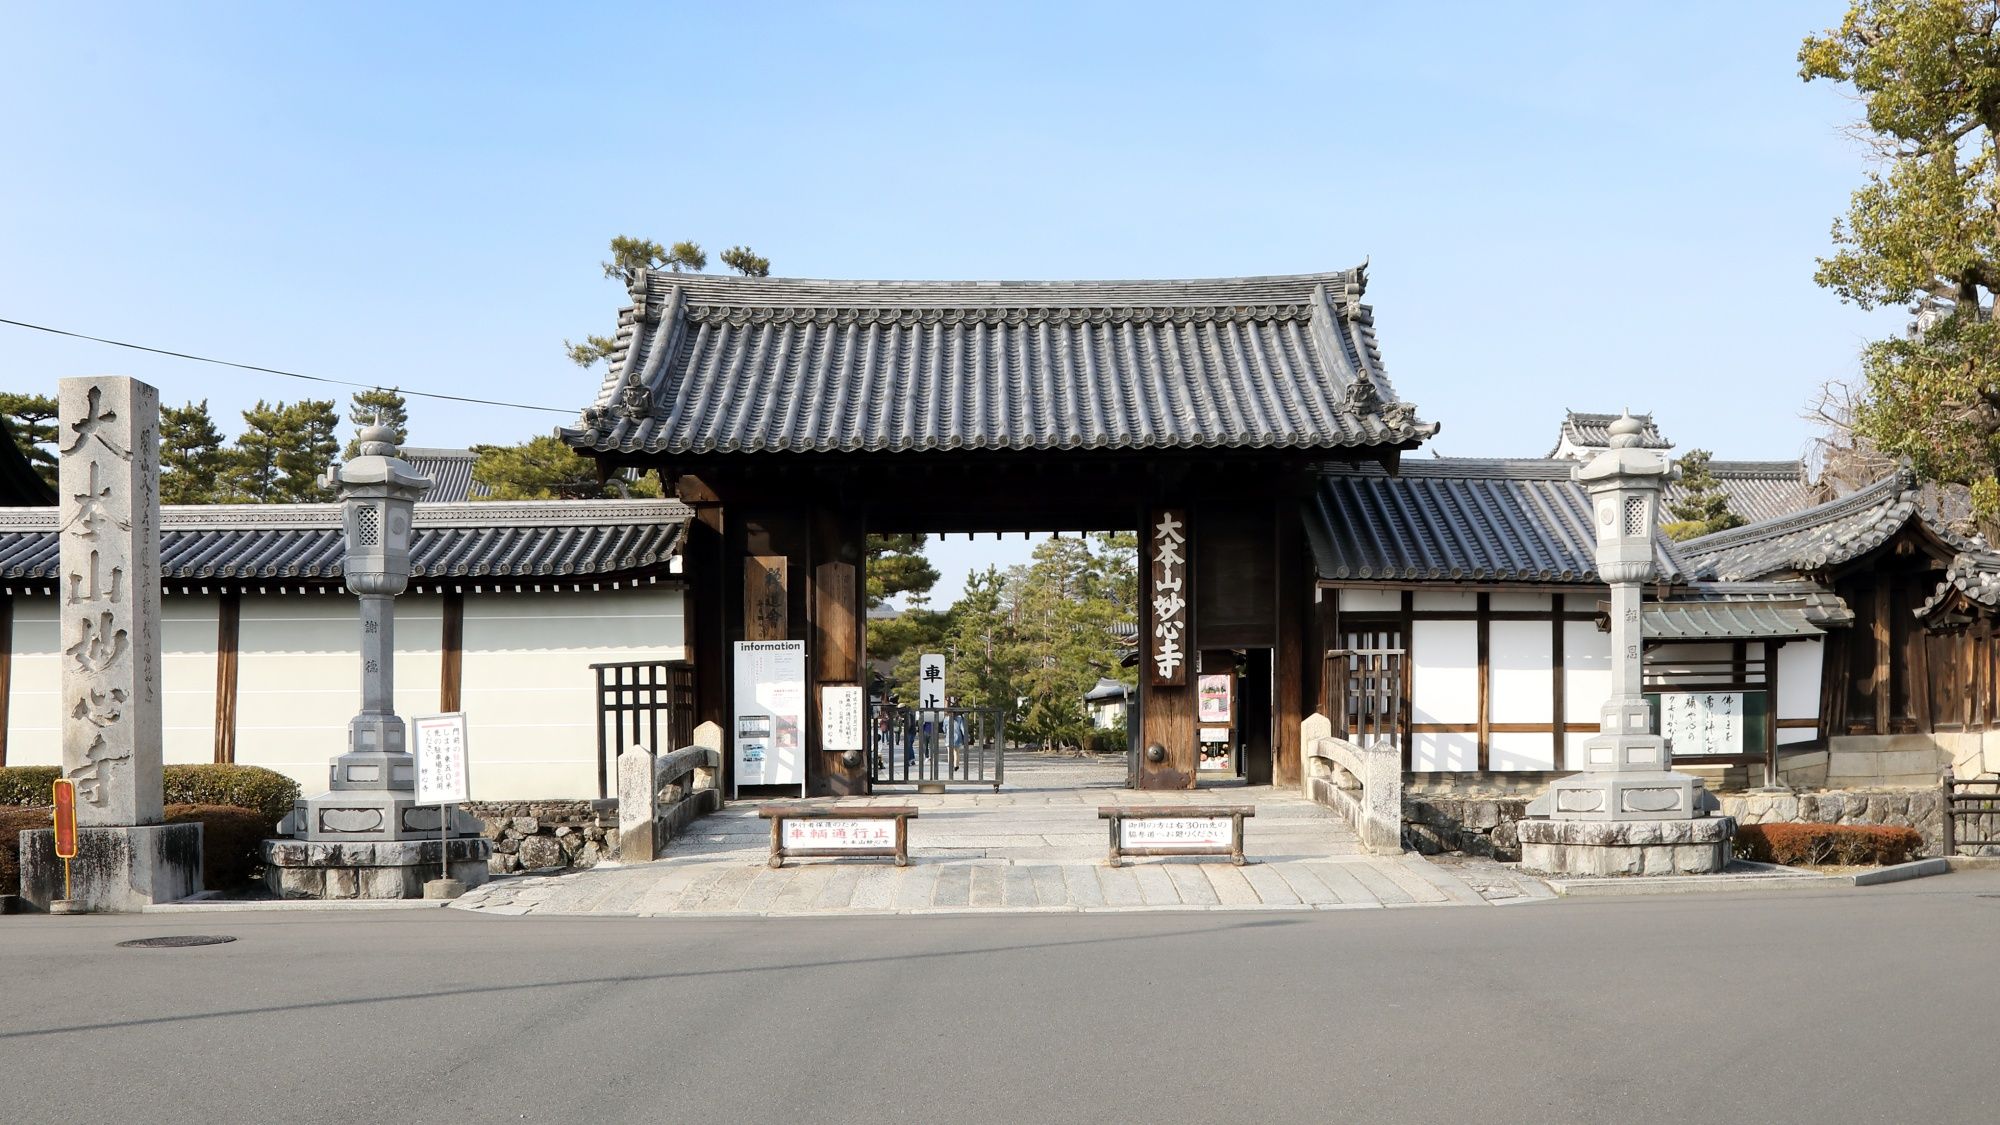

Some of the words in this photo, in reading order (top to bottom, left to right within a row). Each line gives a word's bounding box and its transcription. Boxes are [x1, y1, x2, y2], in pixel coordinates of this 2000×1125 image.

[60, 385, 134, 809] 大本山妙心寺
[1153, 512, 1186, 679] 大本山妙心寺
[740, 641, 801, 651] information
[790, 821, 859, 829] 歩行者保護のため
